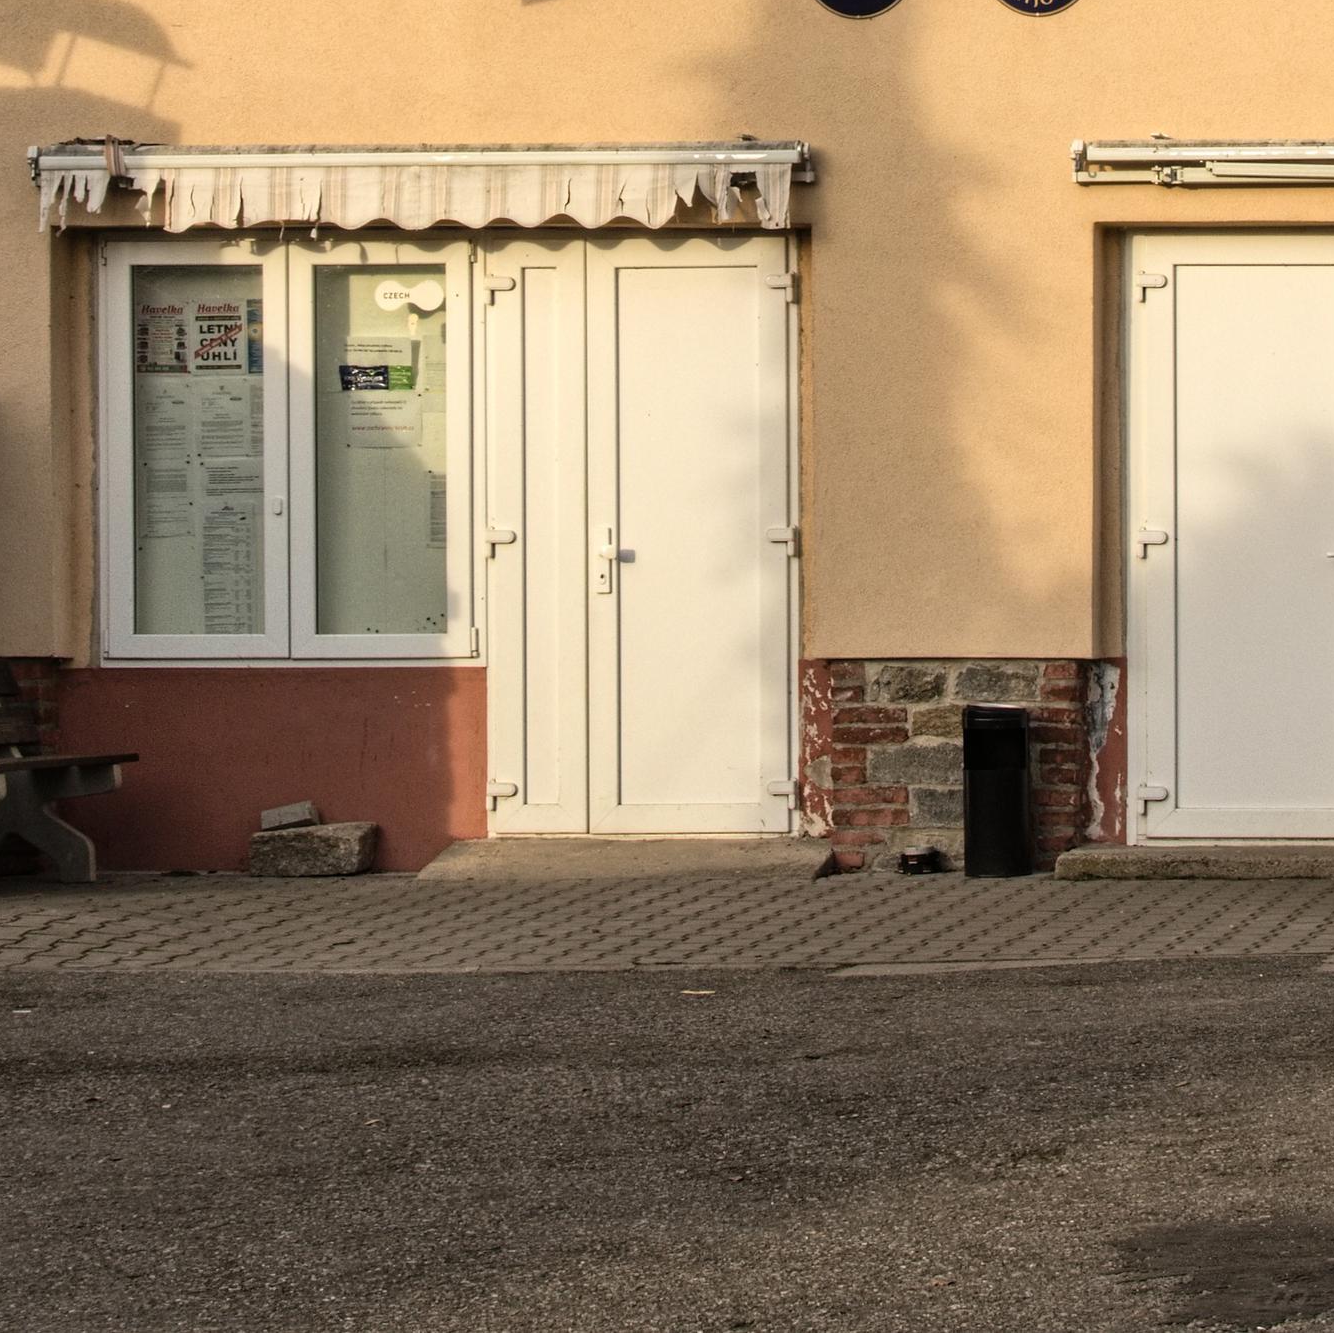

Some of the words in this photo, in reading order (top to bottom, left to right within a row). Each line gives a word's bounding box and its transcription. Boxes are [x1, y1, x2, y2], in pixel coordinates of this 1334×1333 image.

[383, 292, 410, 300] CZECH
[141, 304, 184, 315] Havelka
[197, 303, 240, 314] Havelka
[201, 349, 237, 361] UHLÍ
